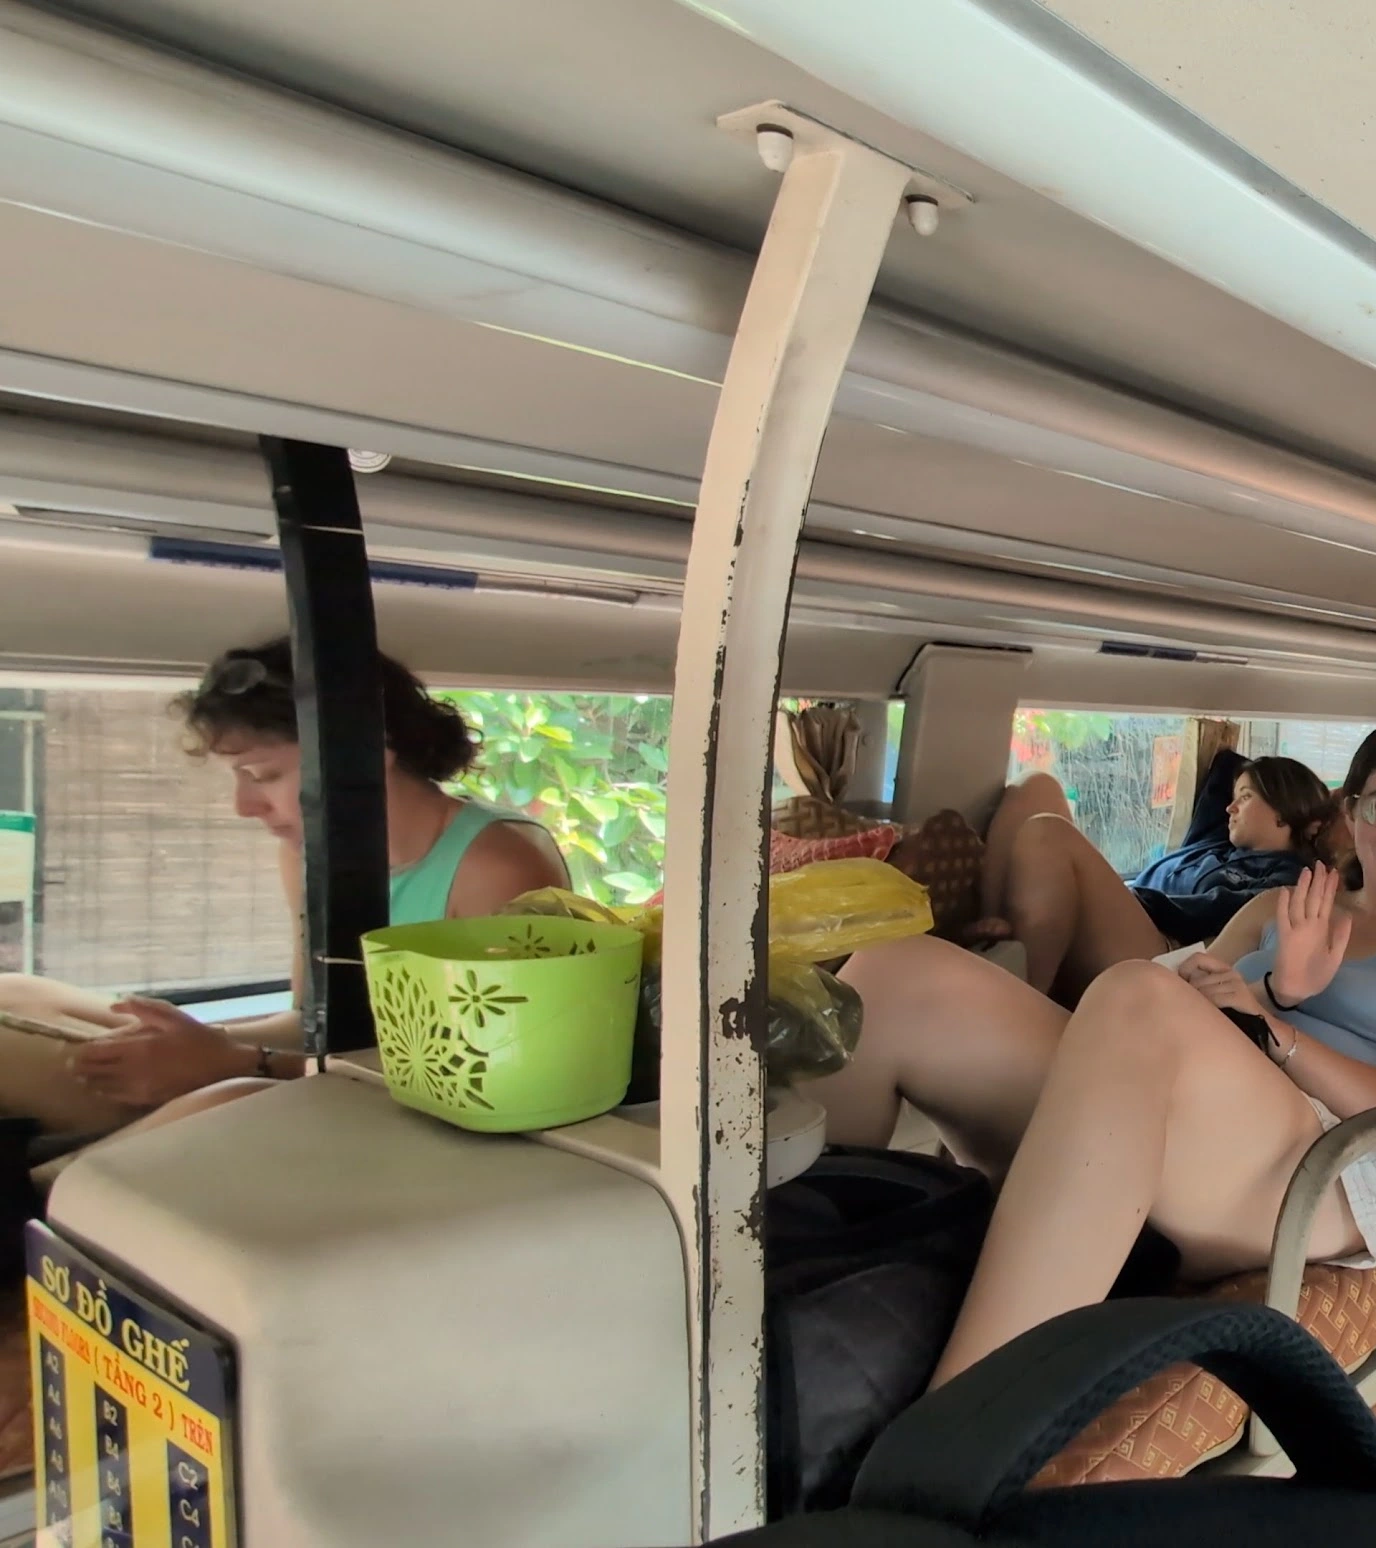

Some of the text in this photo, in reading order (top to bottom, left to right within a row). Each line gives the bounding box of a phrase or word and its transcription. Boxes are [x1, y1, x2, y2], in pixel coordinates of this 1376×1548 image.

[42, 1255, 70, 1303] SƠ
[76, 1279, 112, 1336] ĐỒ
[122, 1318, 190, 1390] GHẾ
[103, 1351, 146, 1408] TẦNG
[153, 1393, 163, 1419] 2
[103, 1400, 118, 1427] B2
[104, 1434, 119, 1461] B4
[178, 1461, 198, 1490] C2
[180, 1499, 200, 1528] C4
